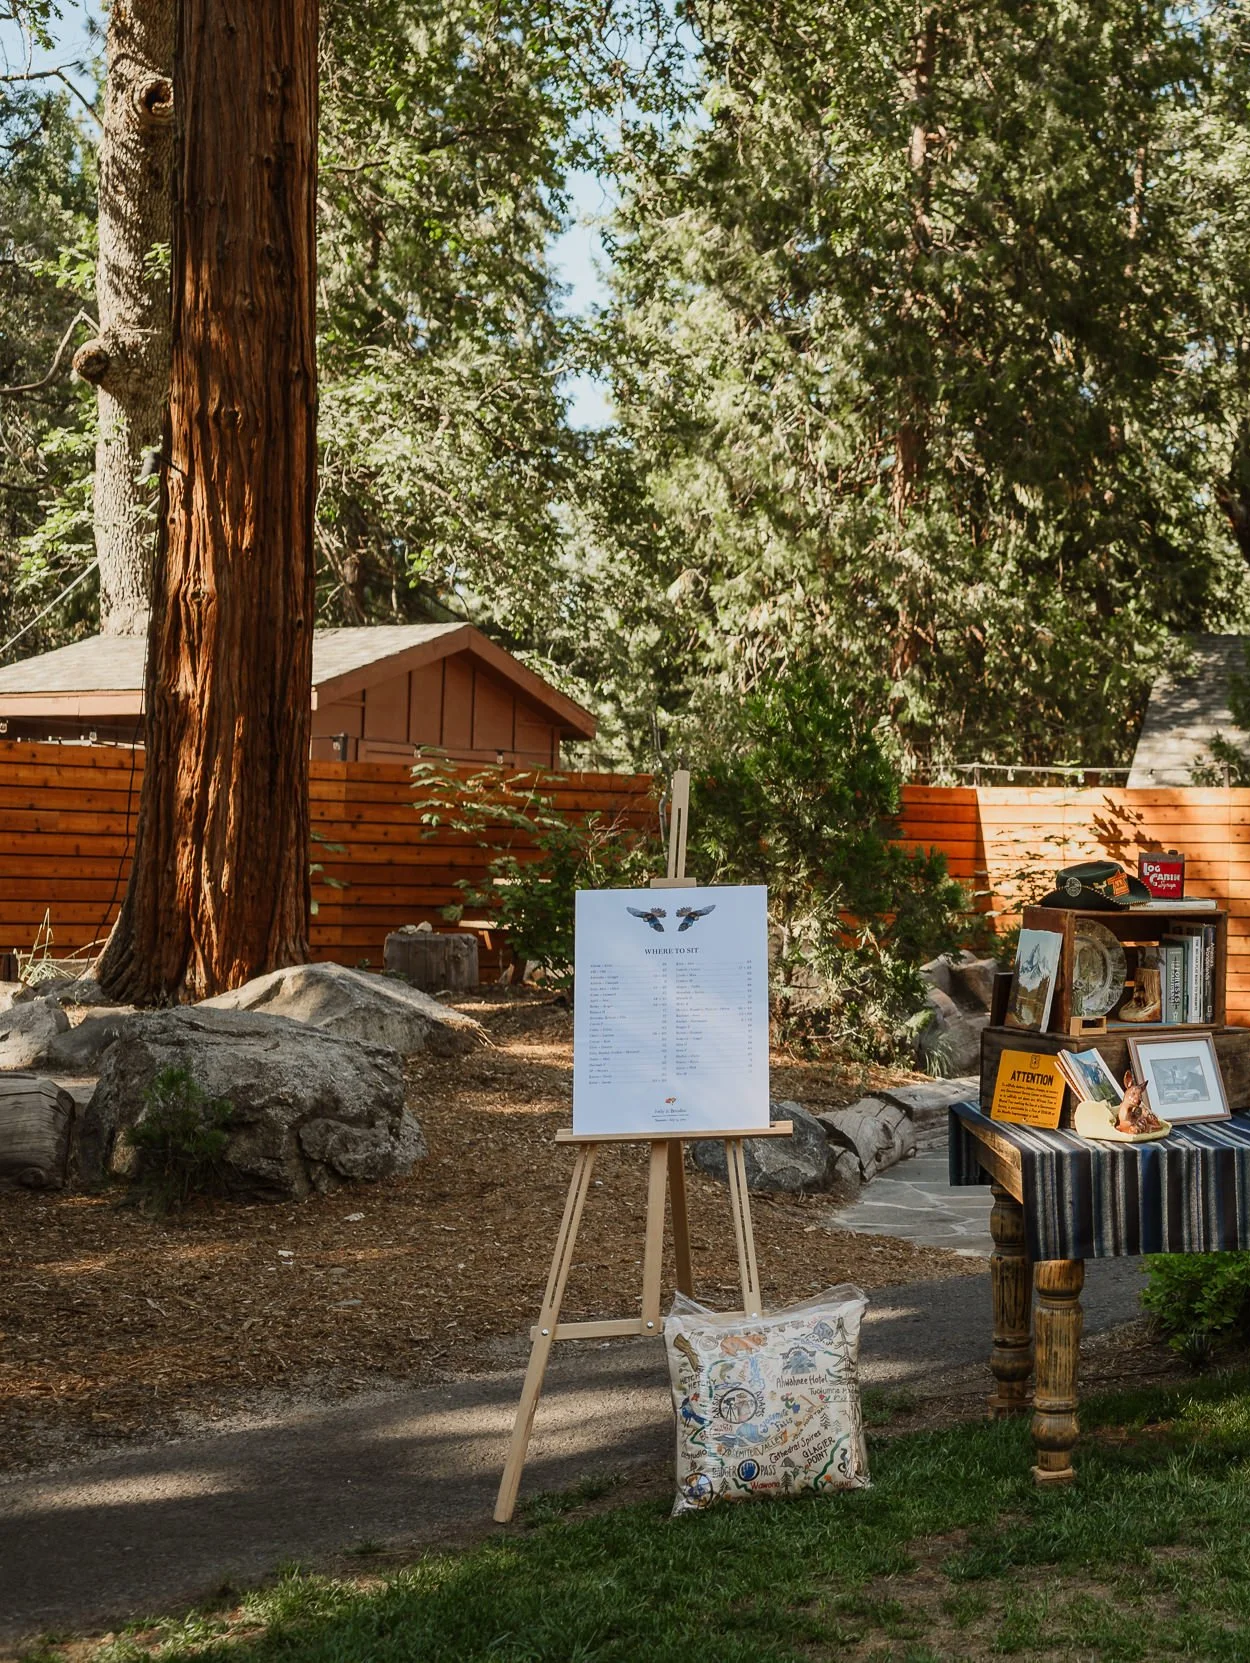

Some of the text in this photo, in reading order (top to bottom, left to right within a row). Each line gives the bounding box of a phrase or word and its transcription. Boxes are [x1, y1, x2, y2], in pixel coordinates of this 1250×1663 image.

[1144, 862, 1160, 876] LOG
[1150, 873, 1180, 886] CABIN
[1010, 1070, 1054, 1086] ATTENTION
[688, 1379, 717, 1390] HETHY
[776, 1374, 828, 1389] Ahwahnee Hotel
[712, 1391, 766, 1418] ANSEL ADAMS
[757, 1435, 783, 1455] VALLEY
[769, 1430, 821, 1464] Cathedral Spires
[807, 1449, 828, 1465] POINT
[760, 1464, 776, 1476] PASS
[750, 1481, 780, 1489] Wawona
